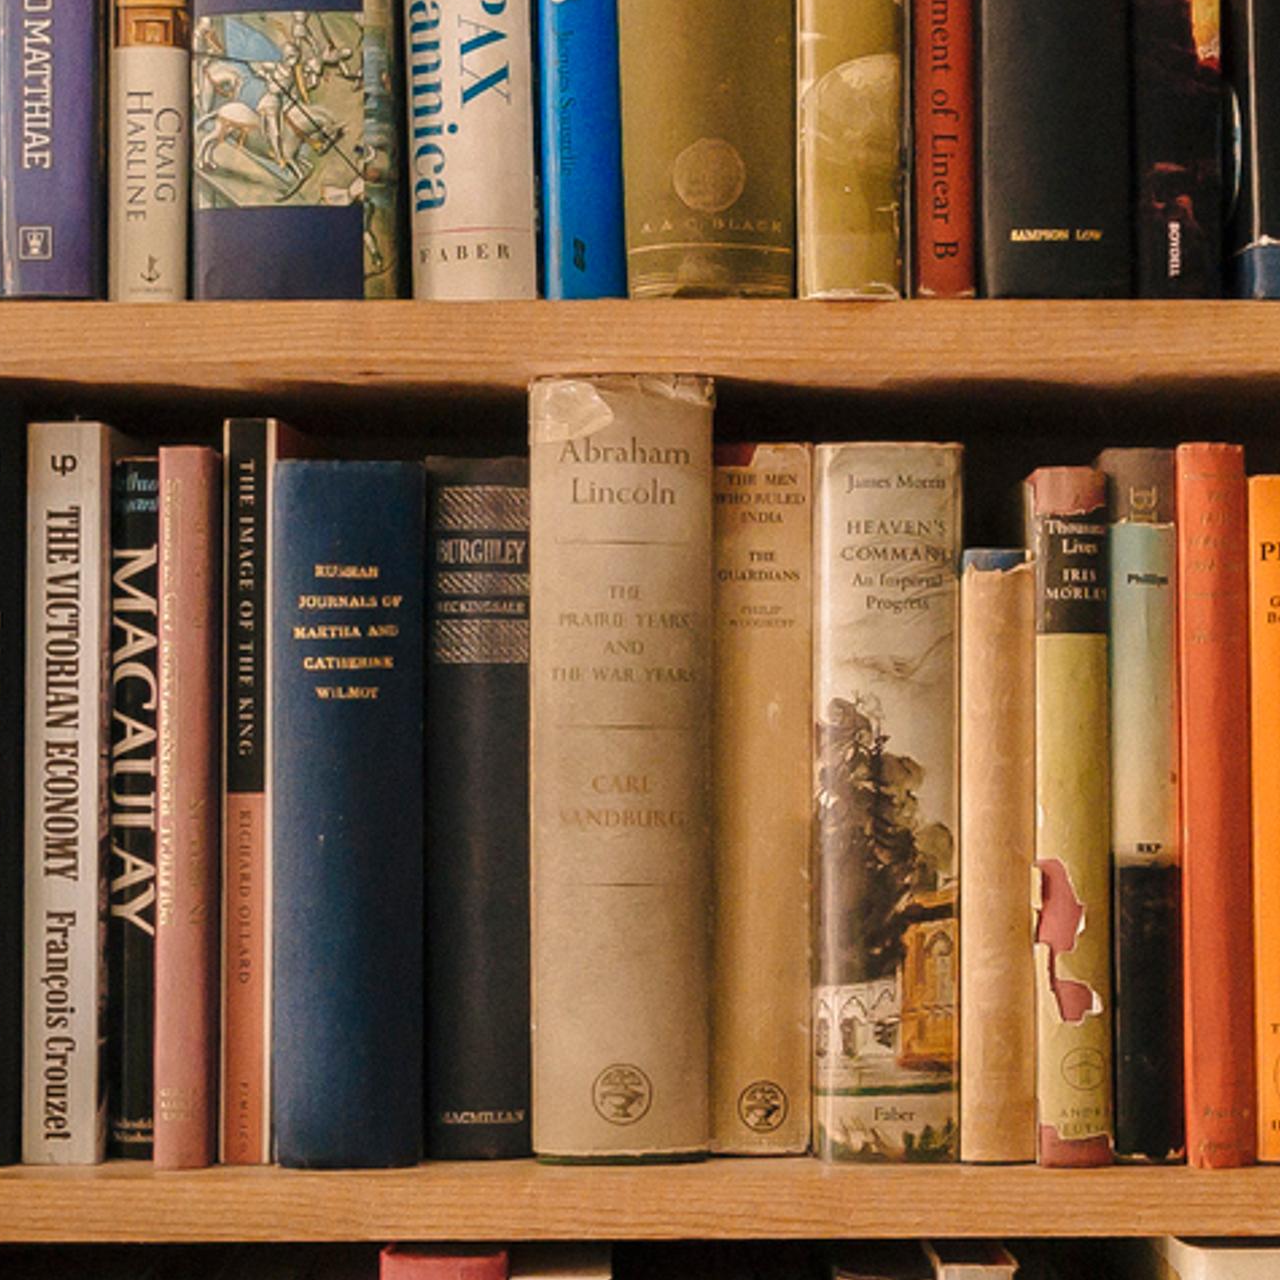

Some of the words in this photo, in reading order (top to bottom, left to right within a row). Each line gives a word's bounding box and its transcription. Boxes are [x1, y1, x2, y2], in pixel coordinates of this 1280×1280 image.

[22, 20, 51, 169] MATTHIAE
[930, 88, 957, 117] of
[930, 133, 957, 223] Linear
[931, 241, 957, 260] B
[239, 460, 255, 501] THE
[559, 438, 690, 466] Abraham
[570, 480, 676, 507] Lincoln
[44, 506, 81, 576] THE
[239, 517, 255, 591] IMAGE
[239, 602, 255, 631] OF
[44, 575, 81, 729] VICTORIAN
[239, 642, 255, 685] THE
[239, 697, 255, 755] KING
[43, 740, 79, 881] ECONOMY
[39, 911, 77, 1029] François
[44, 1036, 76, 1141] Crouzet
[873, 1106, 916, 1123] Faber
